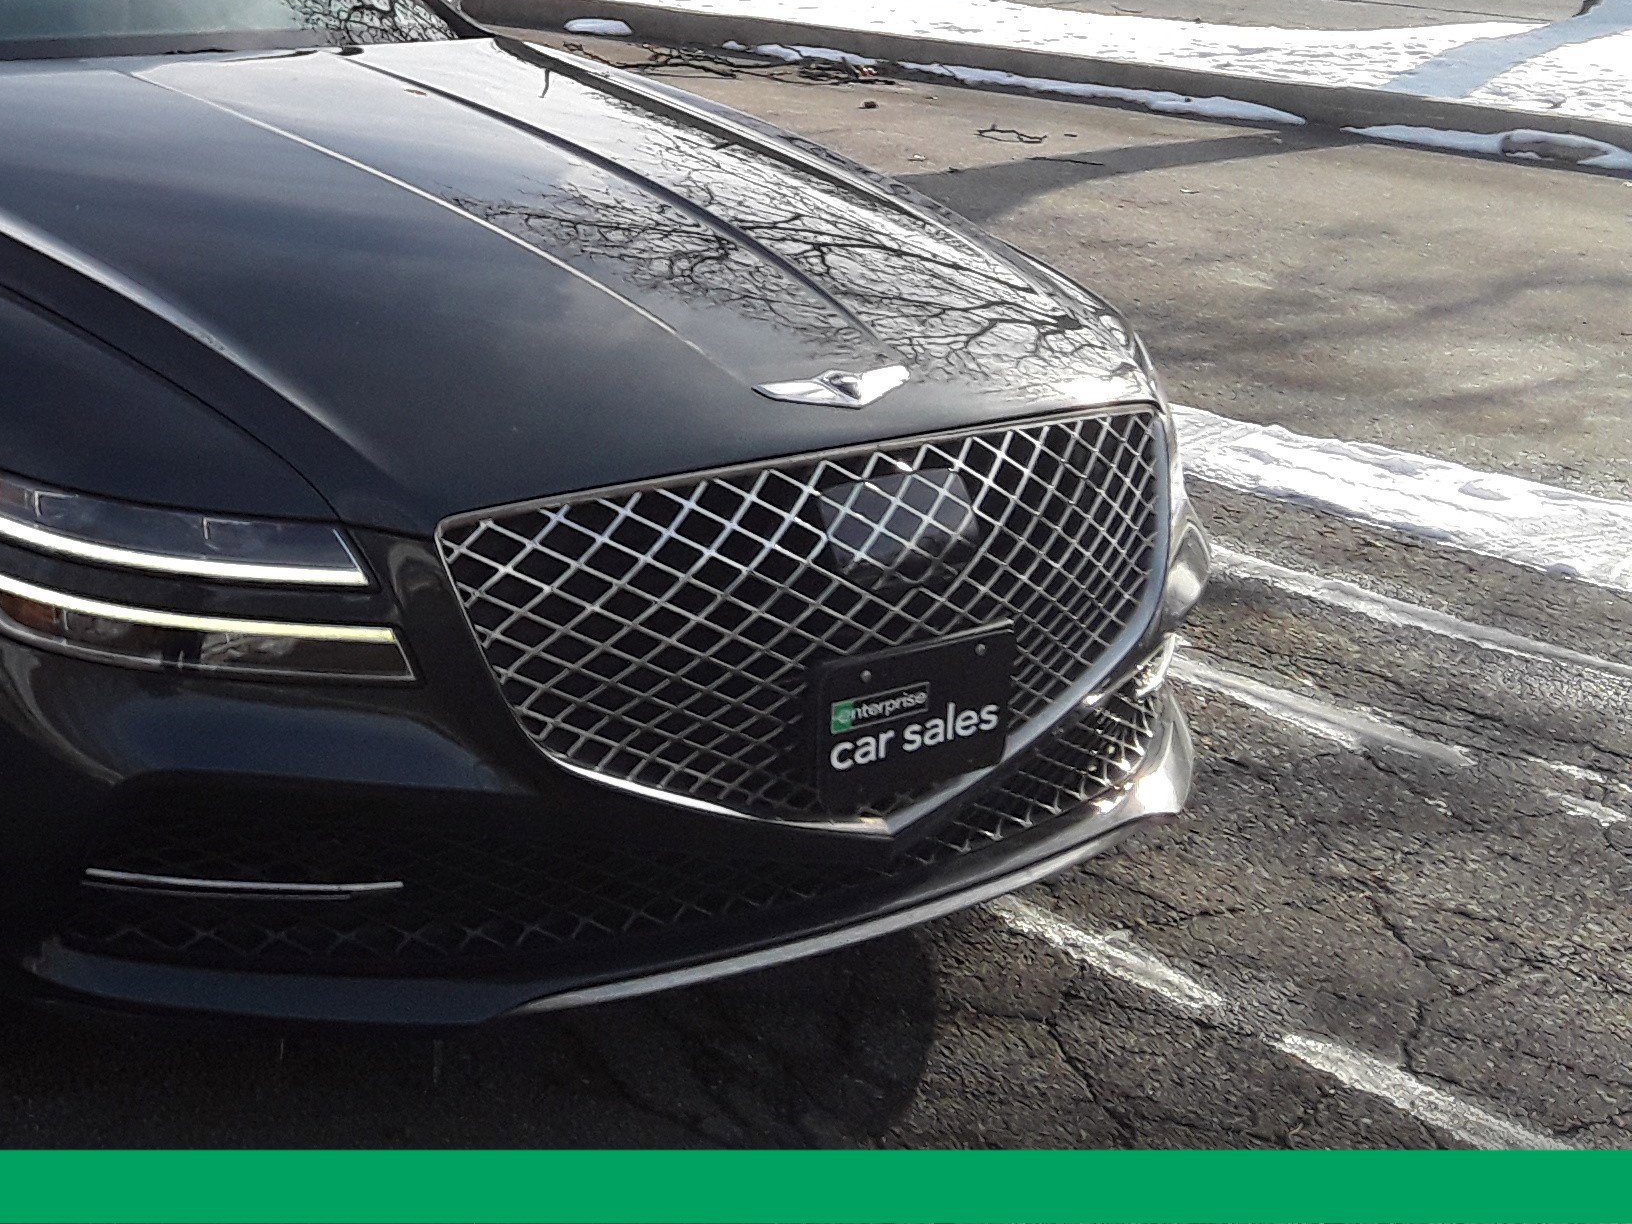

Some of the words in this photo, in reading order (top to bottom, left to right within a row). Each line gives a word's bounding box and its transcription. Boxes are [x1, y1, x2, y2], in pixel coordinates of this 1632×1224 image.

[836, 691, 928, 724] enterprise
[830, 729, 895, 771] car
[902, 701, 999, 752] sales
